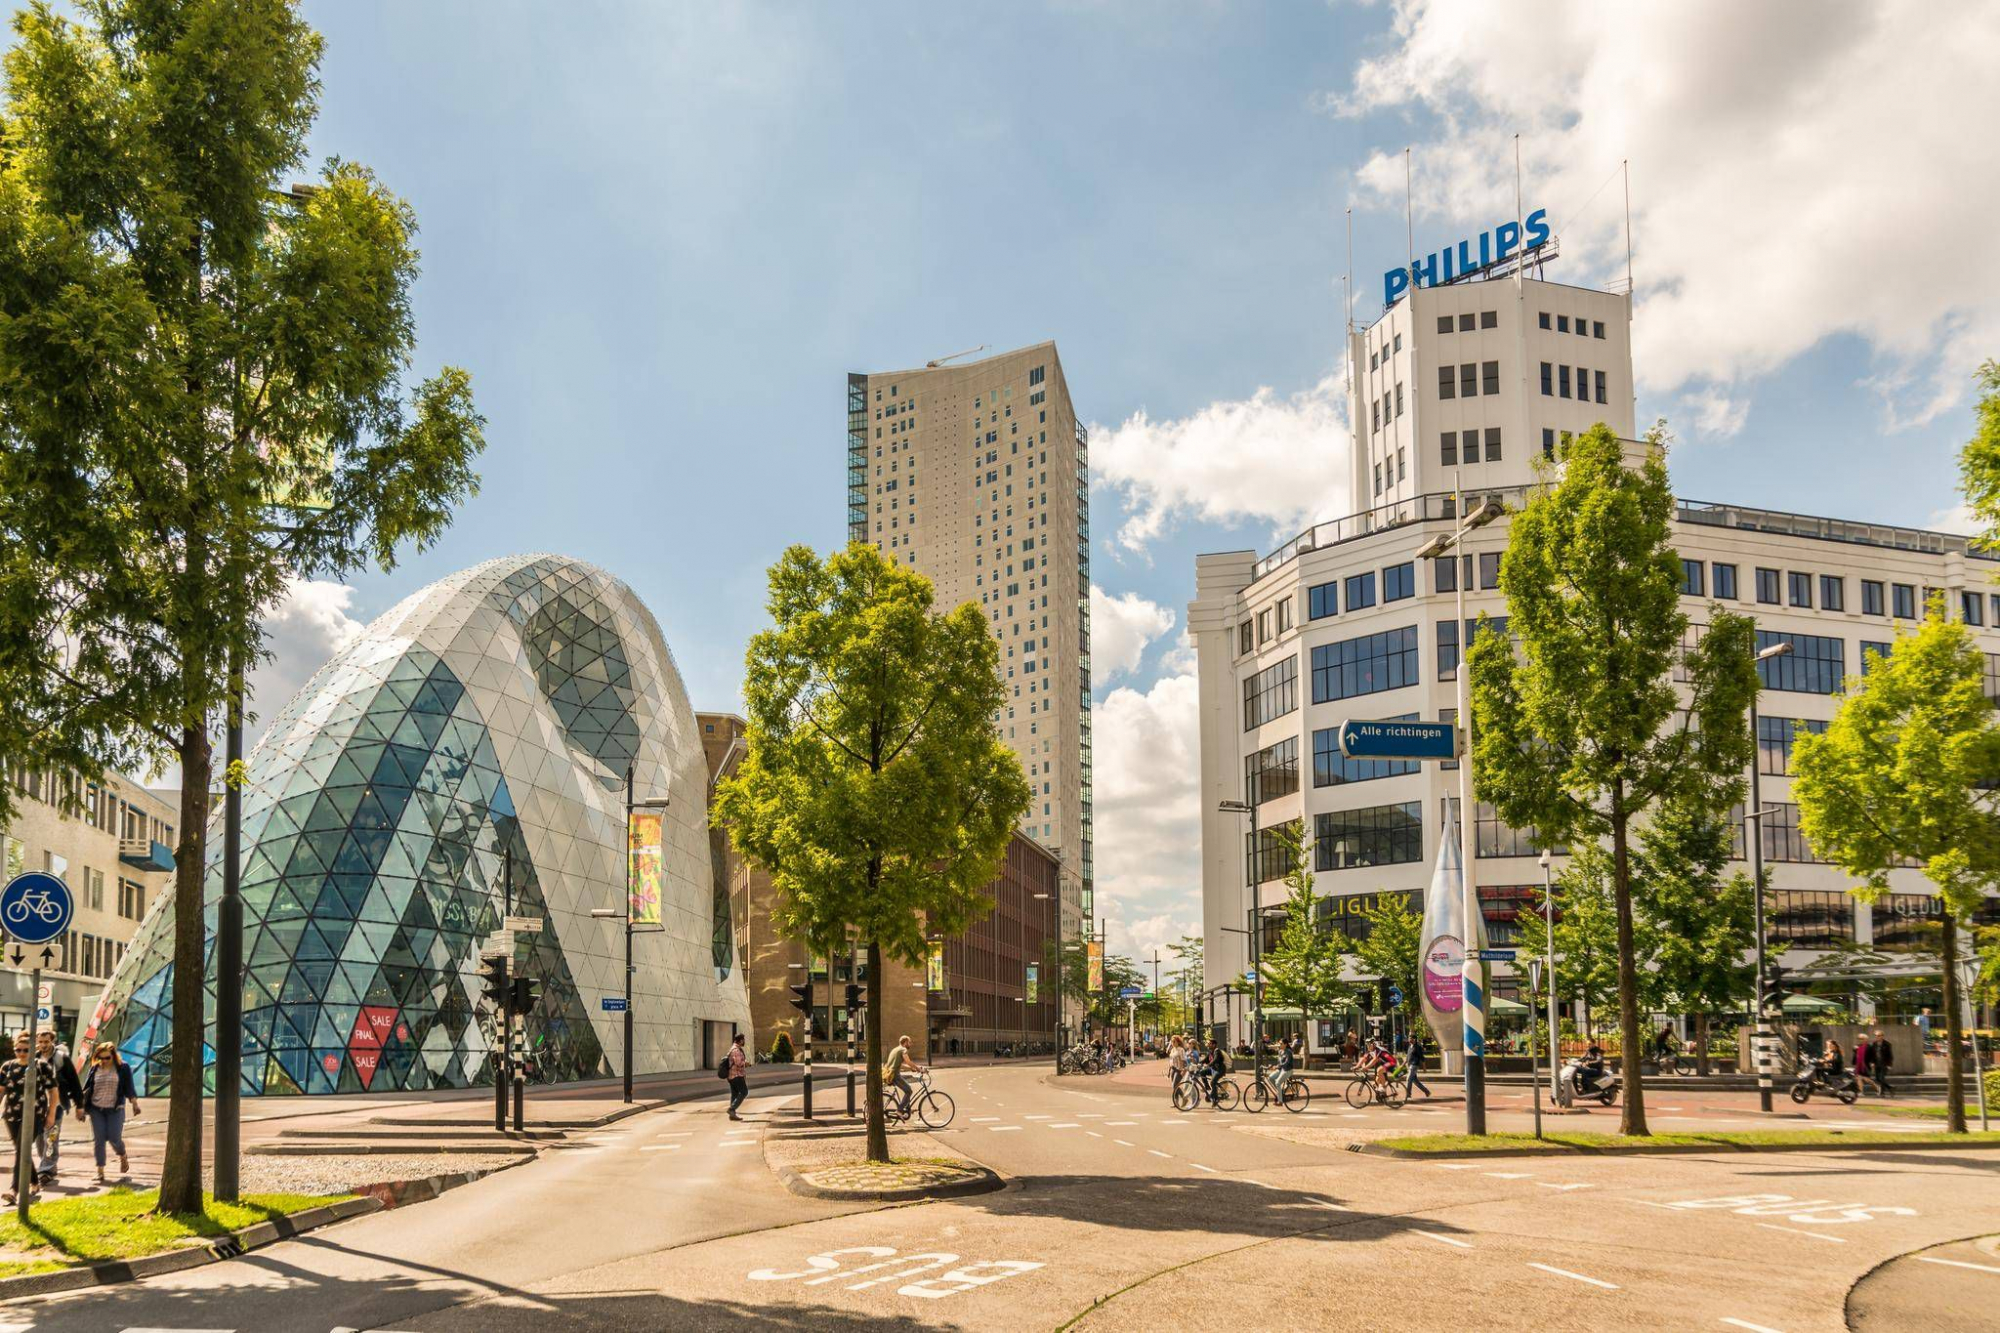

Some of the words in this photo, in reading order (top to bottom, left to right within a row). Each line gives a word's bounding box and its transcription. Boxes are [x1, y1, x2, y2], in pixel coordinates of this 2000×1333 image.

[1384, 208, 1550, 306] PHILIPS
[1360, 725, 1382, 736] Alle
[1386, 726, 1442, 739] richtingen
[1481, 952, 1515, 960] Mathildelaan
[371, 1015, 392, 1027] SALE
[355, 1029, 375, 1040] FINAL
[355, 1056, 376, 1068] SALE
